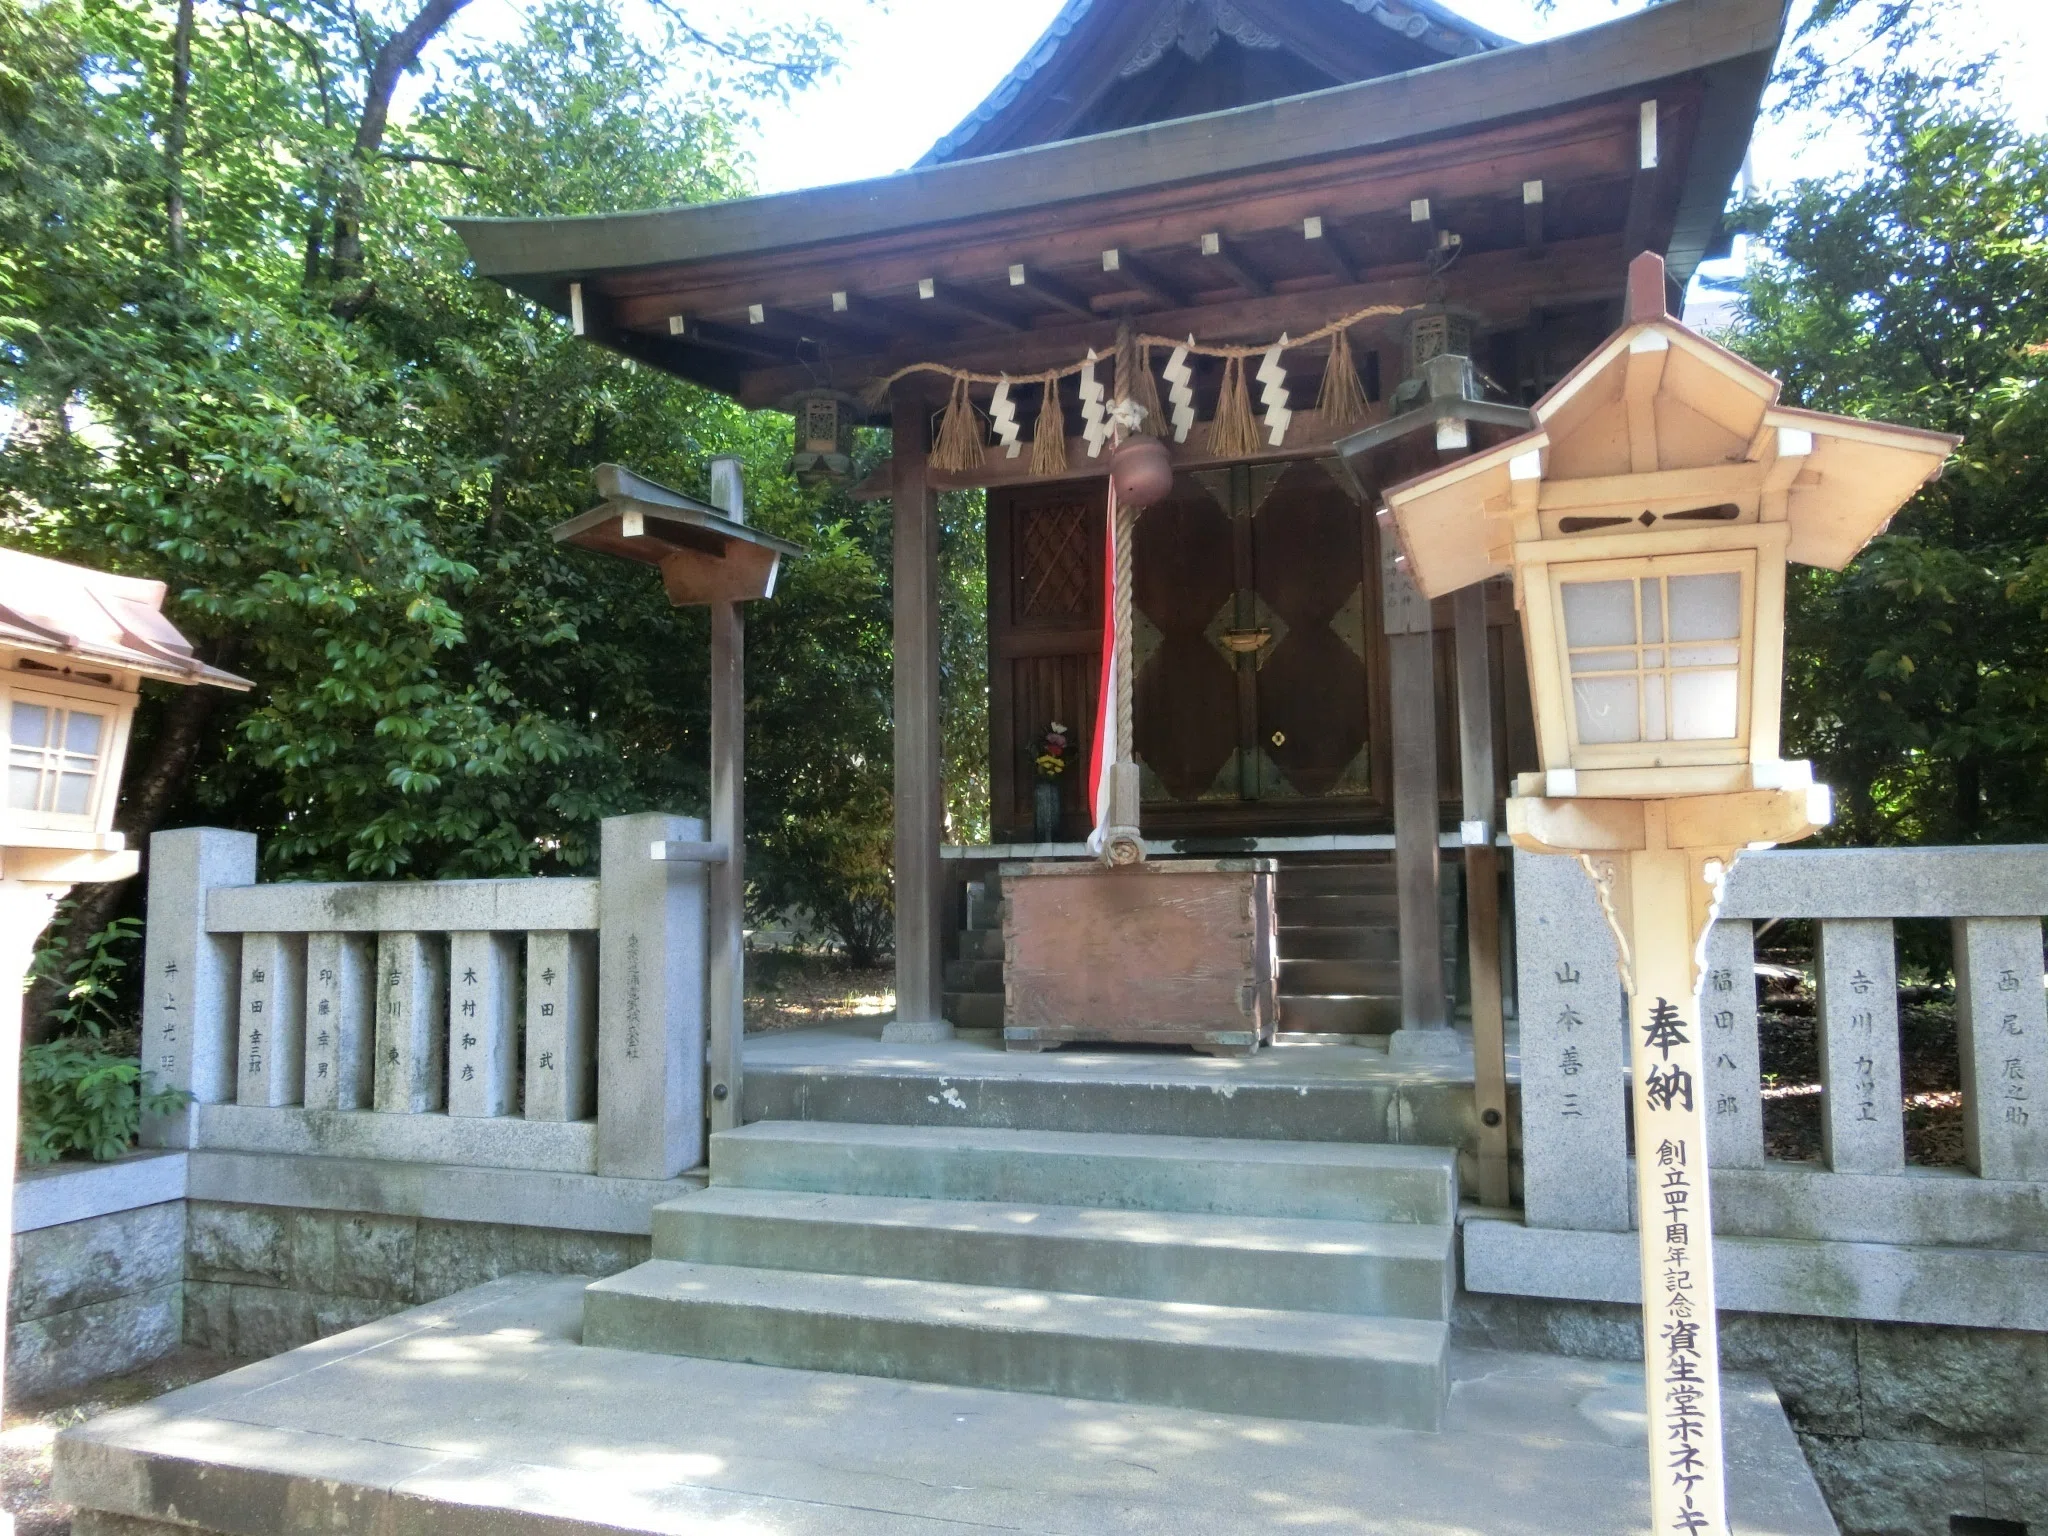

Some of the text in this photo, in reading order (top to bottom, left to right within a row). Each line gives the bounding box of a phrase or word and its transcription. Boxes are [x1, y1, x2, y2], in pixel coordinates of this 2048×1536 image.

[461, 967, 477, 1081] 木村和彦
[539, 967, 556, 1070] 寺田武
[1554, 961, 1583, 1117] 山本善三
[1641, 996, 1694, 1113] 奉納
[1712, 968, 1738, 1115] 福田八郎
[1998, 969, 2029, 1127] 西尾辰之助
